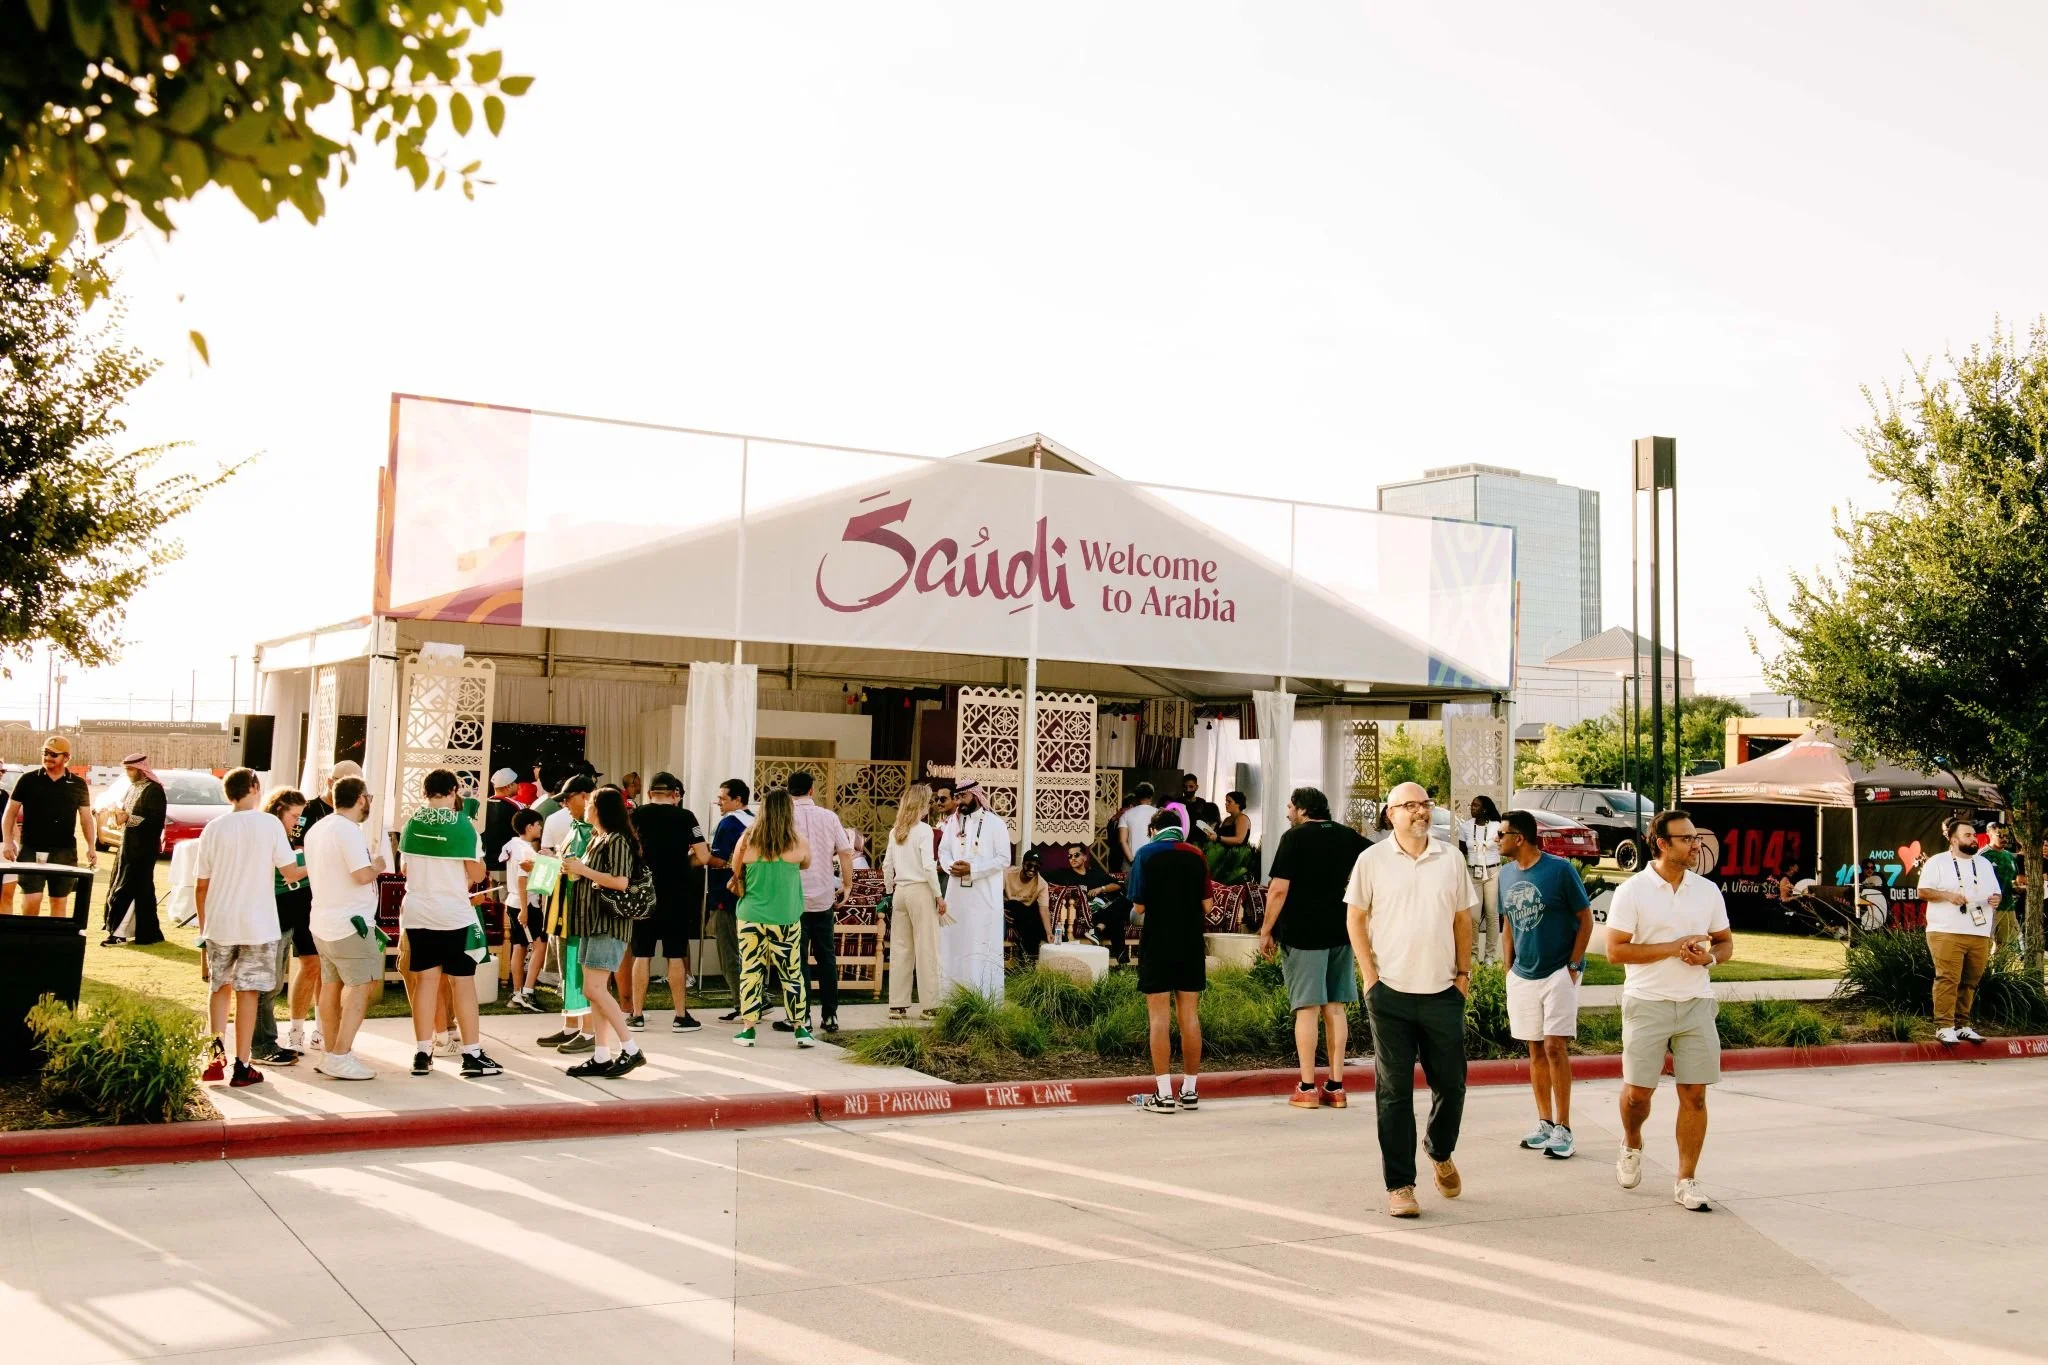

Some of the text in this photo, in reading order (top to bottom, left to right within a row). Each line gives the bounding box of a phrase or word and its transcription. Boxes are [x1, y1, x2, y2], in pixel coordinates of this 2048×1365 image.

[1079, 540, 1217, 583] Welcome
[1102, 584, 1236, 622] to Arabia
[1869, 850, 1895, 860] AMOR
[1508, 903, 1545, 920] Vintage
[844, 1083, 1077, 1114] NO PARKING FIRE LANE
